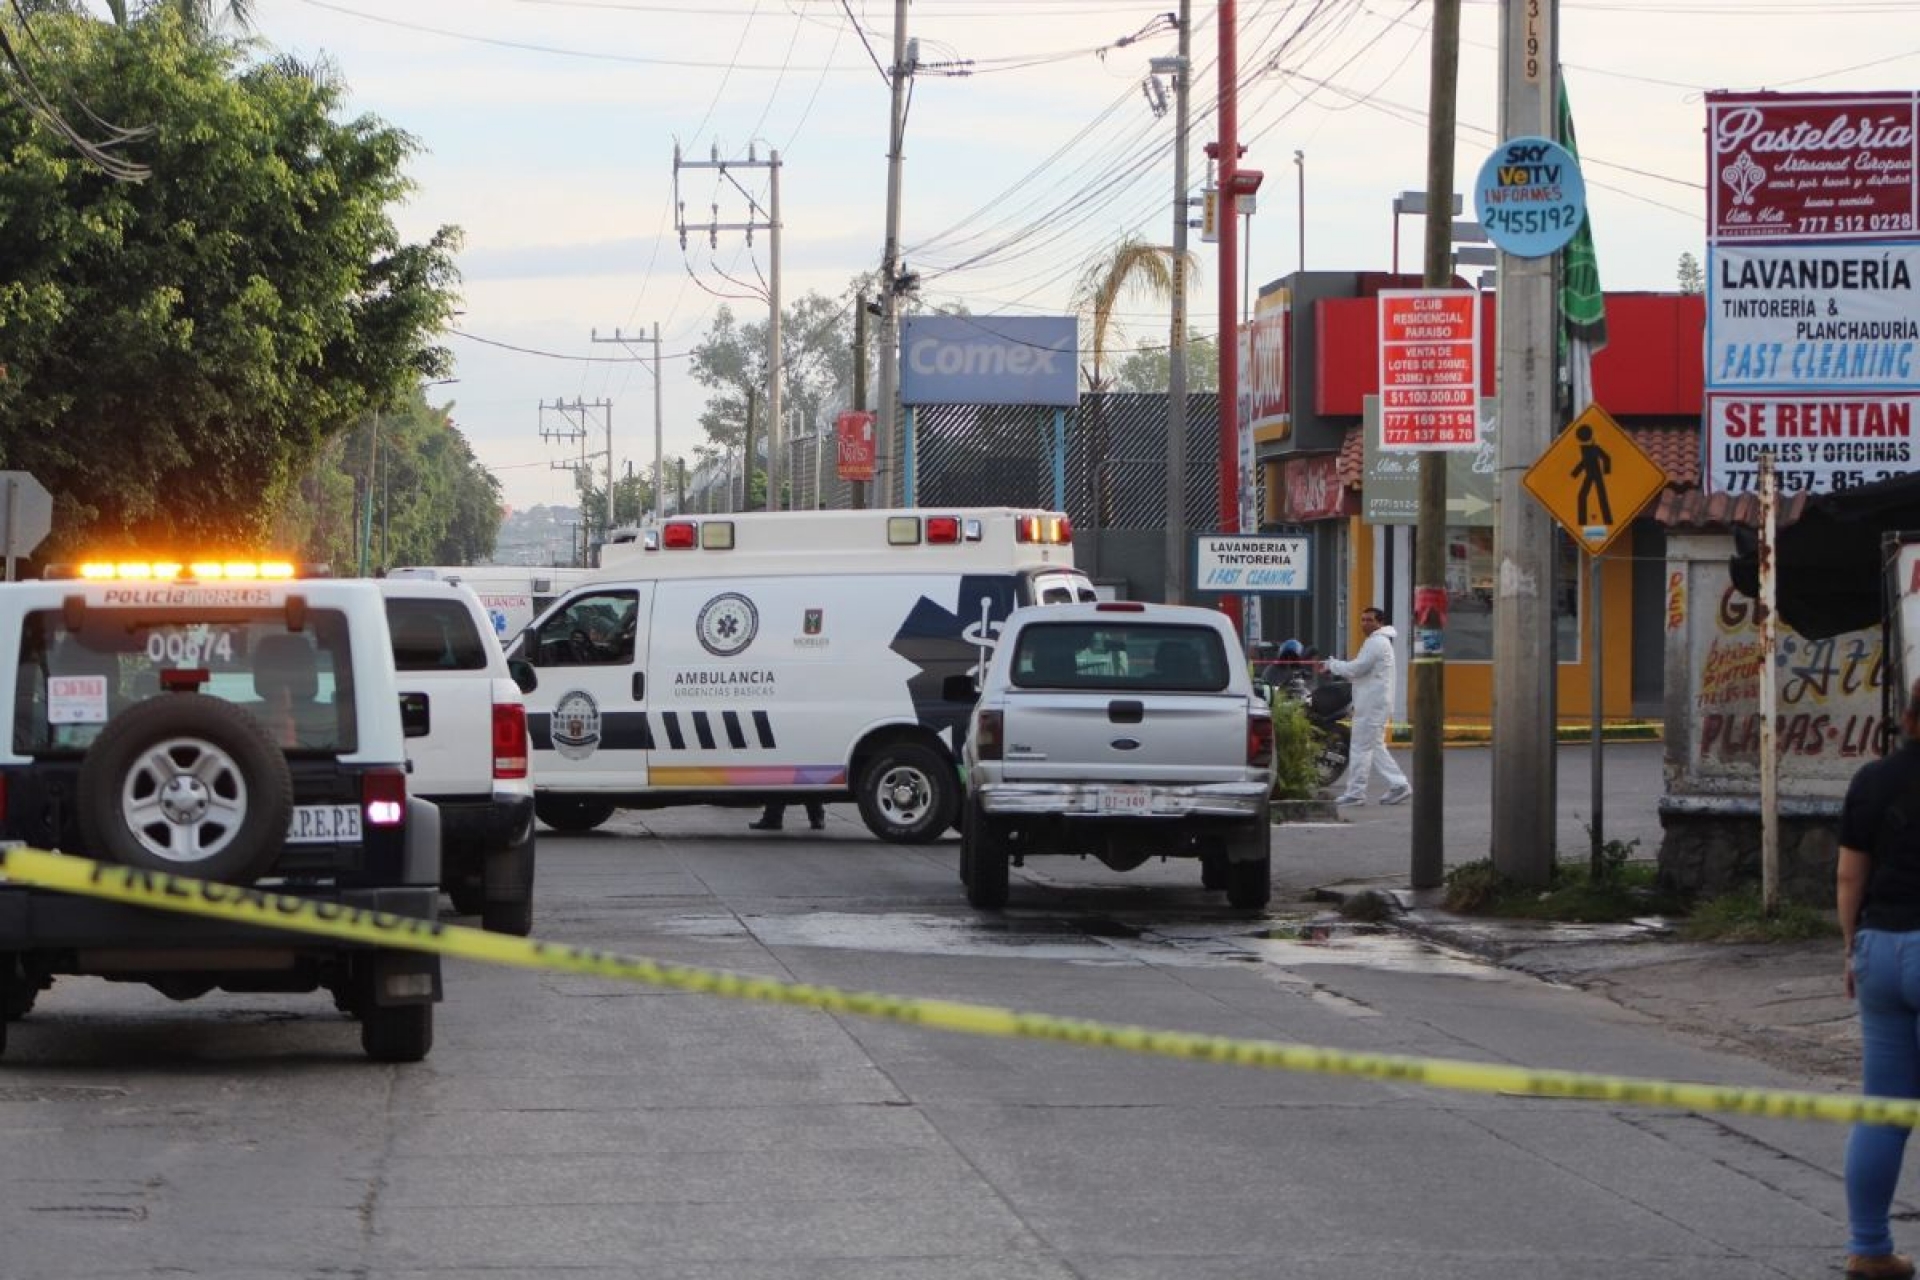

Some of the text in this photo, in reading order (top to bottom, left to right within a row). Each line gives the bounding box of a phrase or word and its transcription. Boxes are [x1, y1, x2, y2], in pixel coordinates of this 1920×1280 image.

[1716, 107, 1912, 154] Pastelería
[1506, 144, 1553, 163] SKY
[1484, 185, 1563, 204] INFORMES
[1484, 204, 1576, 234] 2455192
[1799, 213, 1911, 233] 777 512 0228
[1722, 252, 1912, 290] LAVANDERÍA
[1413, 299, 1443, 310] CLUB
[1723, 296, 1839, 318] TINTORERÍA &
[1393, 312, 1464, 325] RESIDENCIAL
[1796, 317, 1919, 340] PLANCHADURÍA
[909, 336, 1071, 375] Comex
[1406, 346, 1452, 358] VENTA DE
[1720, 342, 1914, 380] FAST CLEANING
[1388, 359, 1420, 371] LOTES
[1386, 414, 1409, 427] 777
[1724, 402, 1911, 438] SE RENTAN
[1386, 430, 1409, 441] 777
[1807, 443, 1819, 463] Y
[1823, 441, 1910, 463] OFICINAS
[1210, 542, 1299, 553] LAVANDERIA Y
[1217, 554, 1292, 565] TINTORERIA
[674, 669, 776, 686] AMBULANCIA
[674, 686, 730, 698] URGENCIAS
